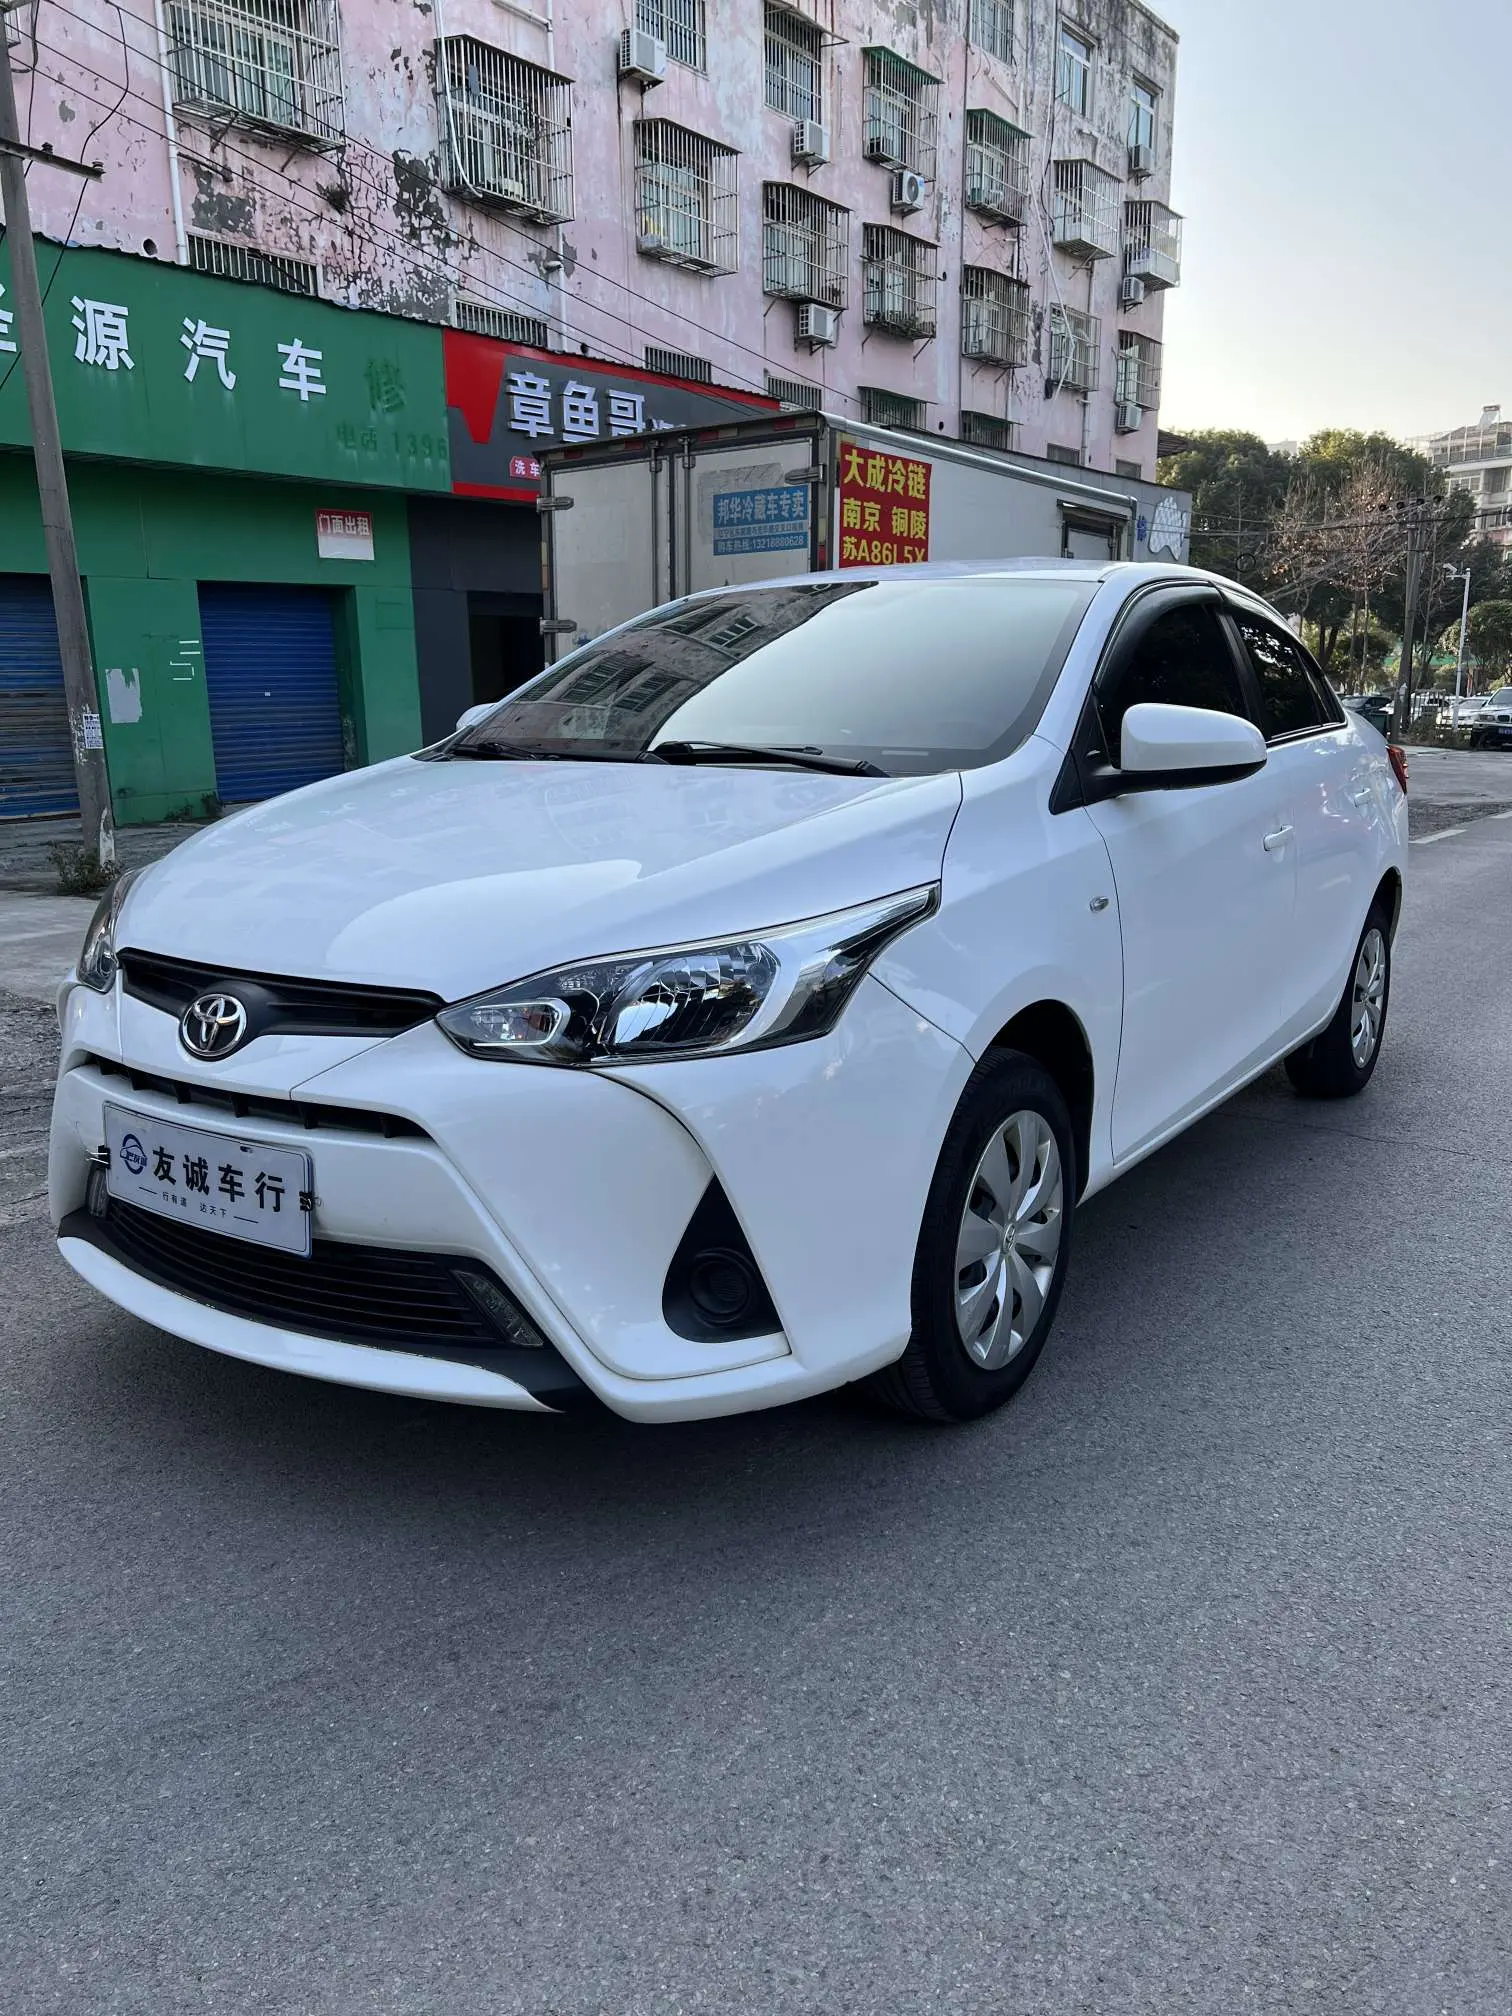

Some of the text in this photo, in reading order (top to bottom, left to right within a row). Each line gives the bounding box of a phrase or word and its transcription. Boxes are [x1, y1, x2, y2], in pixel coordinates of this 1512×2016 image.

[506, 371, 686, 443] 章鱼哥
[843, 449, 926, 500] 大成冷链
[318, 513, 370, 536] 门面出租
[843, 497, 881, 532] 南京
[891, 506, 926, 540] 铜陵
[153, 1146, 285, 1212] 友诚车行
